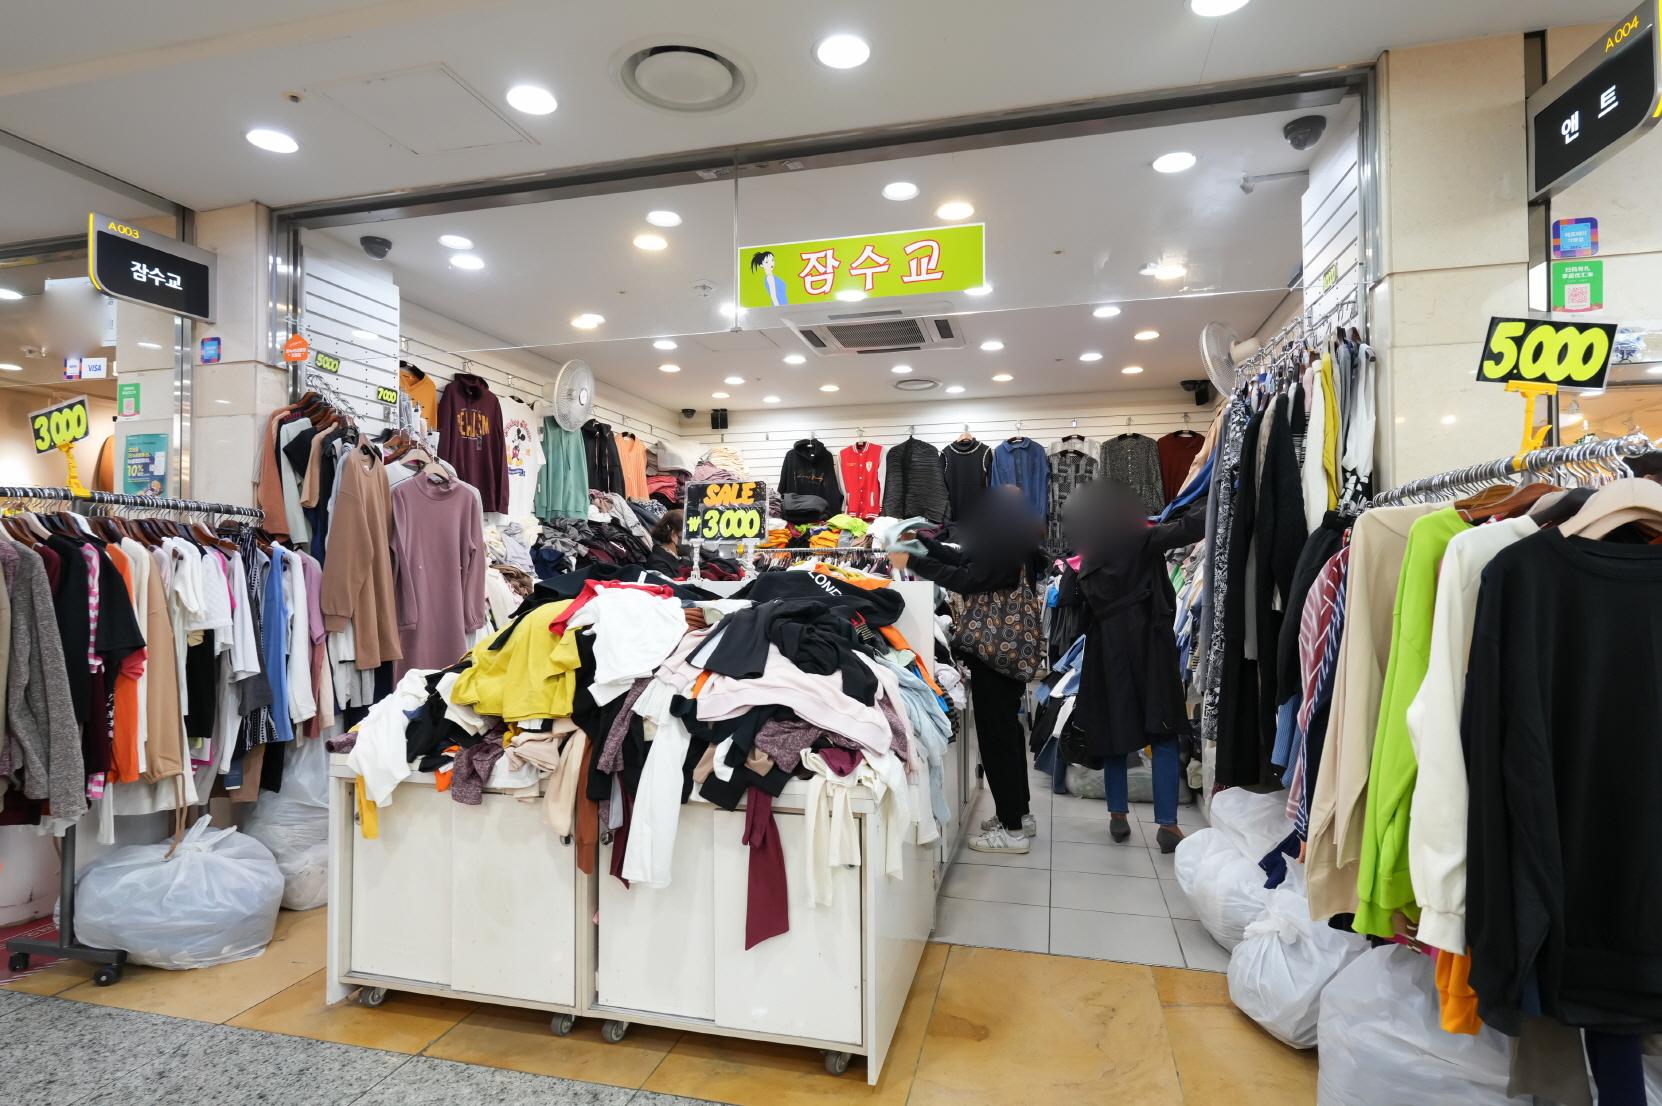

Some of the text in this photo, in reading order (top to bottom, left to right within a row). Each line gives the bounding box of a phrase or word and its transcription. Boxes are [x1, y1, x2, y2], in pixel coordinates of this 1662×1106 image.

[1605, 15, 1640, 53] A004
[1561, 84, 1619, 145] 앤 트
[108, 222, 141, 239] A003
[130, 260, 183, 291] 잠수교
[88, 364, 102, 372] VISA
[703, 482, 757, 507] SALE
